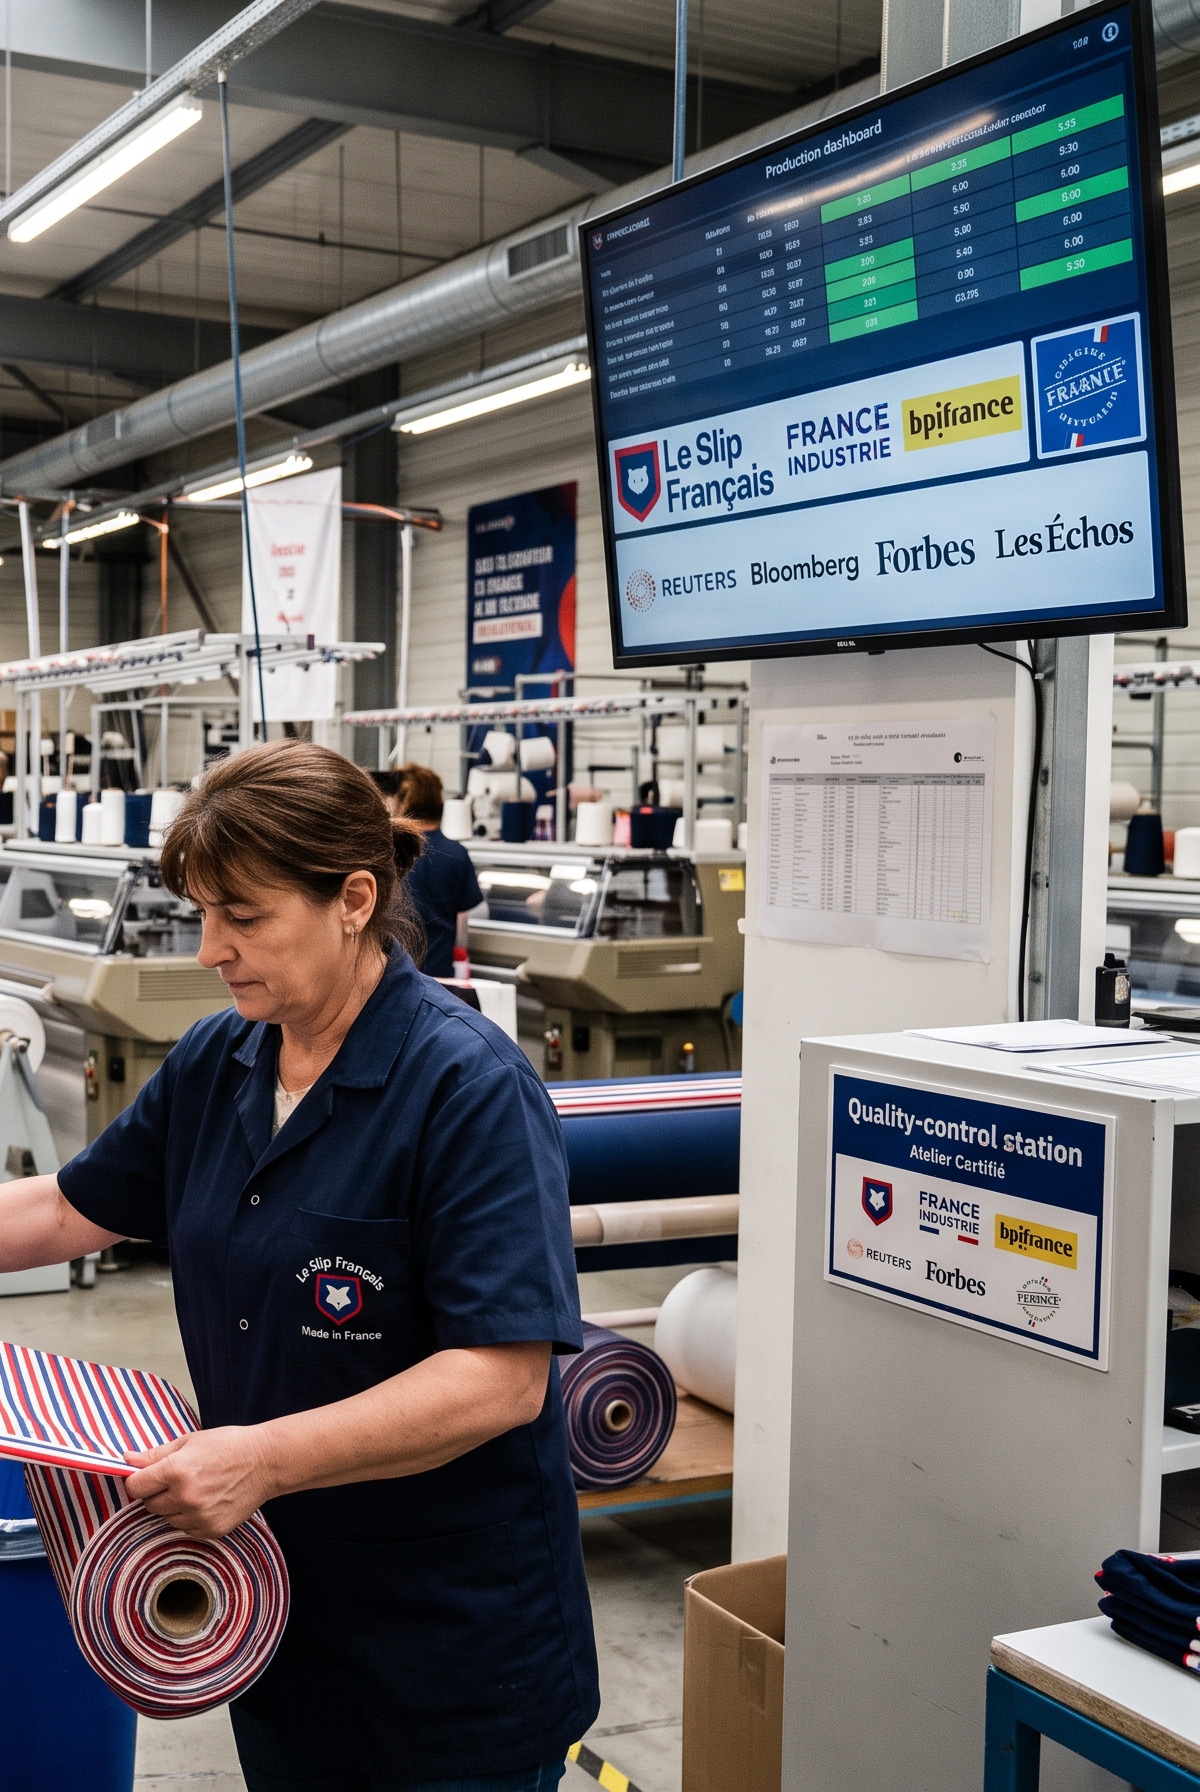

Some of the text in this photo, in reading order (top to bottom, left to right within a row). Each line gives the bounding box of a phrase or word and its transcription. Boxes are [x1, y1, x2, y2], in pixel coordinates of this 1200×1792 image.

[765, 148, 821, 179] Production
[823, 119, 882, 155] dashboard
[786, 402, 890, 449] FRANCE
[909, 393, 1014, 440] bpifrance
[663, 428, 742, 472] Le Slip
[788, 437, 892, 476] INDUSTRIE
[666, 463, 775, 513] Français
[995, 514, 1135, 560] Les Échos
[750, 553, 860, 585] Bloomberg
[875, 535, 975, 576] Forbes
[661, 570, 737, 597] REUTERS
[848, 1097, 1083, 1168] Quality-control station
[909, 1144, 952, 1167] Atelier
[919, 1190, 980, 1221] FRANCE
[919, 1209, 980, 1235] INDUSTRIE
[1000, 1222, 1073, 1258] bpifrance
[296, 1267, 309, 1283] Le
[309, 1257, 331, 1271] Slip
[866, 1248, 912, 1271] REUTERS
[925, 1260, 986, 1296] Forbes
[301, 1325, 382, 1340] Made in France
